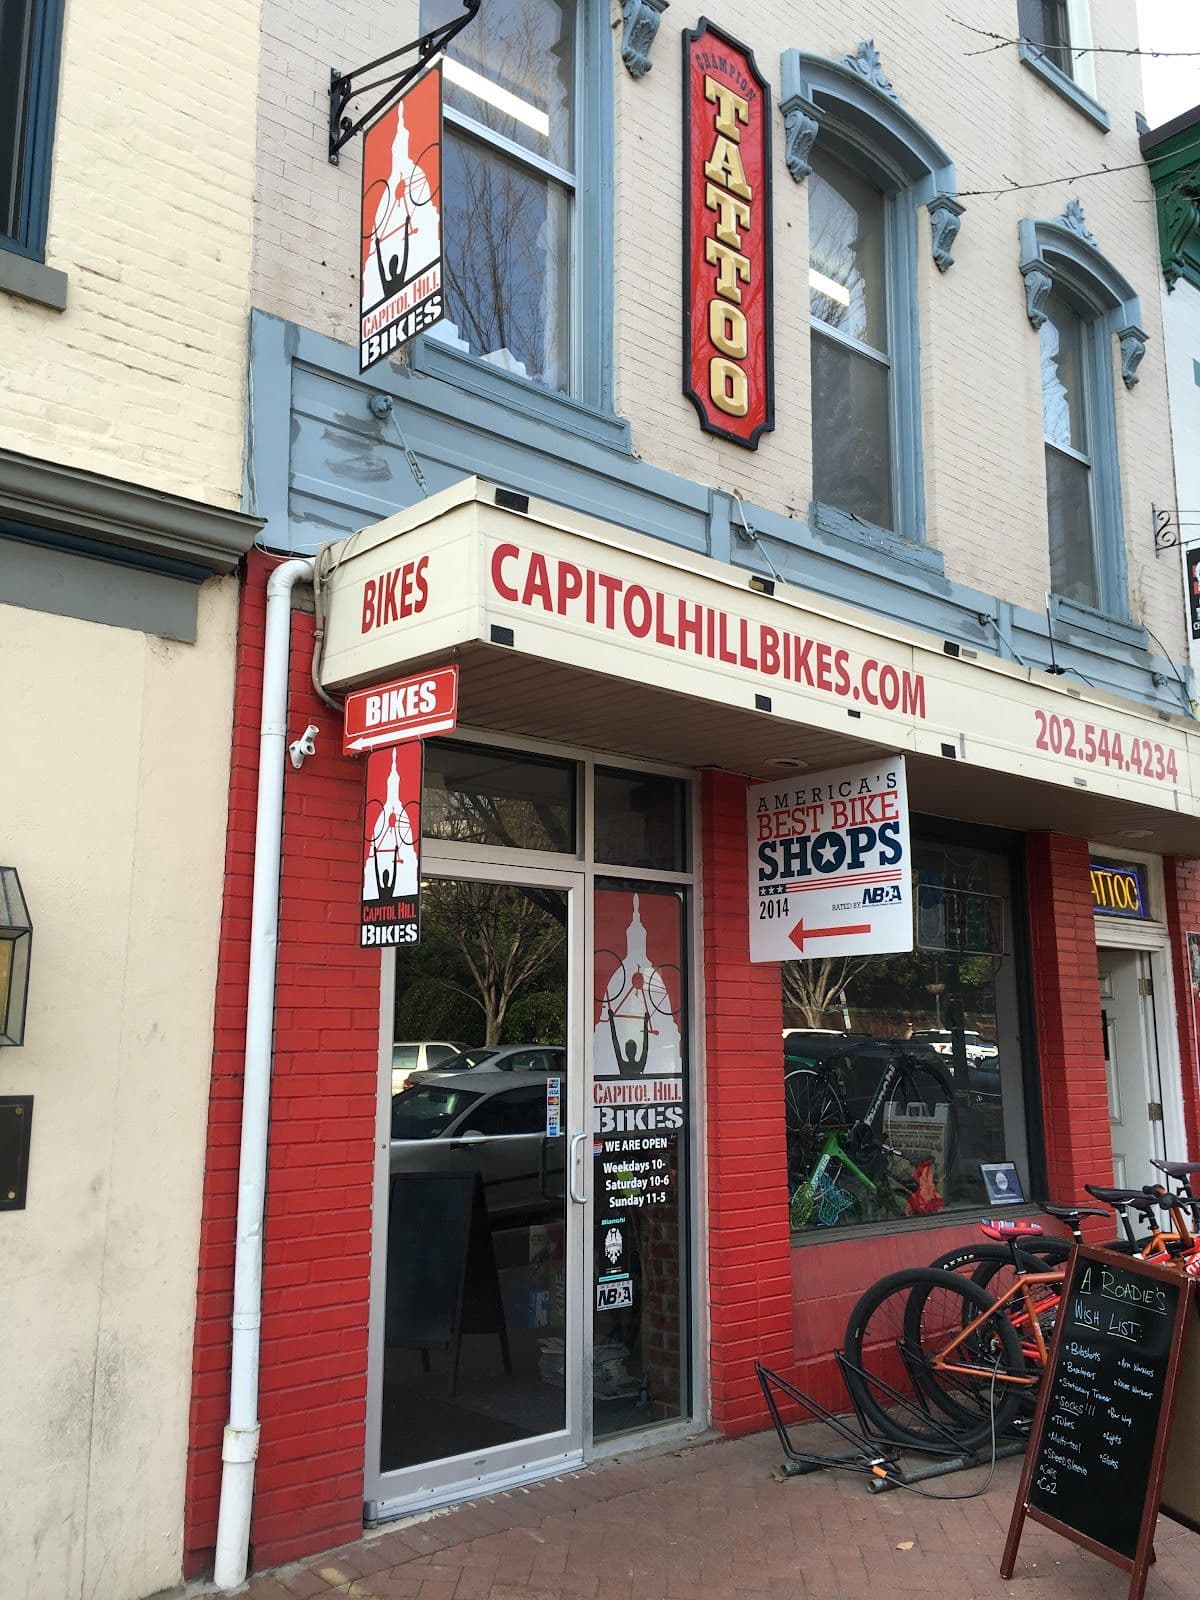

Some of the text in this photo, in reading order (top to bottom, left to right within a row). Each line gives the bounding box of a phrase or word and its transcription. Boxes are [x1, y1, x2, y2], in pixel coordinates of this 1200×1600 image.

[695, 52, 756, 101] CHAMPION
[704, 74, 753, 417] TATTOO
[363, 271, 440, 338] CAPITOL HILL
[361, 295, 442, 369] BIKES
[361, 555, 429, 634] BIKES
[491, 543, 926, 719] CAPITOLHILLBIKES.COM
[365, 680, 437, 727] BIKES
[1034, 709, 1178, 784] 202.544.4234
[756, 772, 897, 813] AMERICA'S
[756, 790, 900, 842] BEST BIKE
[758, 821, 903, 882] SHOPS
[759, 897, 862, 920] 2014 RATED BY
[1090, 869, 1139, 912] ATTOO
[363, 901, 417, 922] CAPITOL HILL
[361, 923, 418, 946] BIKES
[593, 1080, 682, 1104] CAPITOL HILL
[593, 1106, 684, 1133] BIKES
[604, 1140, 620, 1152] WE
[621, 1139, 641, 1151] ARE
[641, 1138, 668, 1149] OPEN
[603, 1160, 650, 1174] Weekdays
[605, 1174, 670, 1191] Saturday 10-6
[609, 1192, 666, 1208] Sunday 11-5
[943, 1254, 975, 1270] AXXIS
[1081, 1267, 1092, 1292] A
